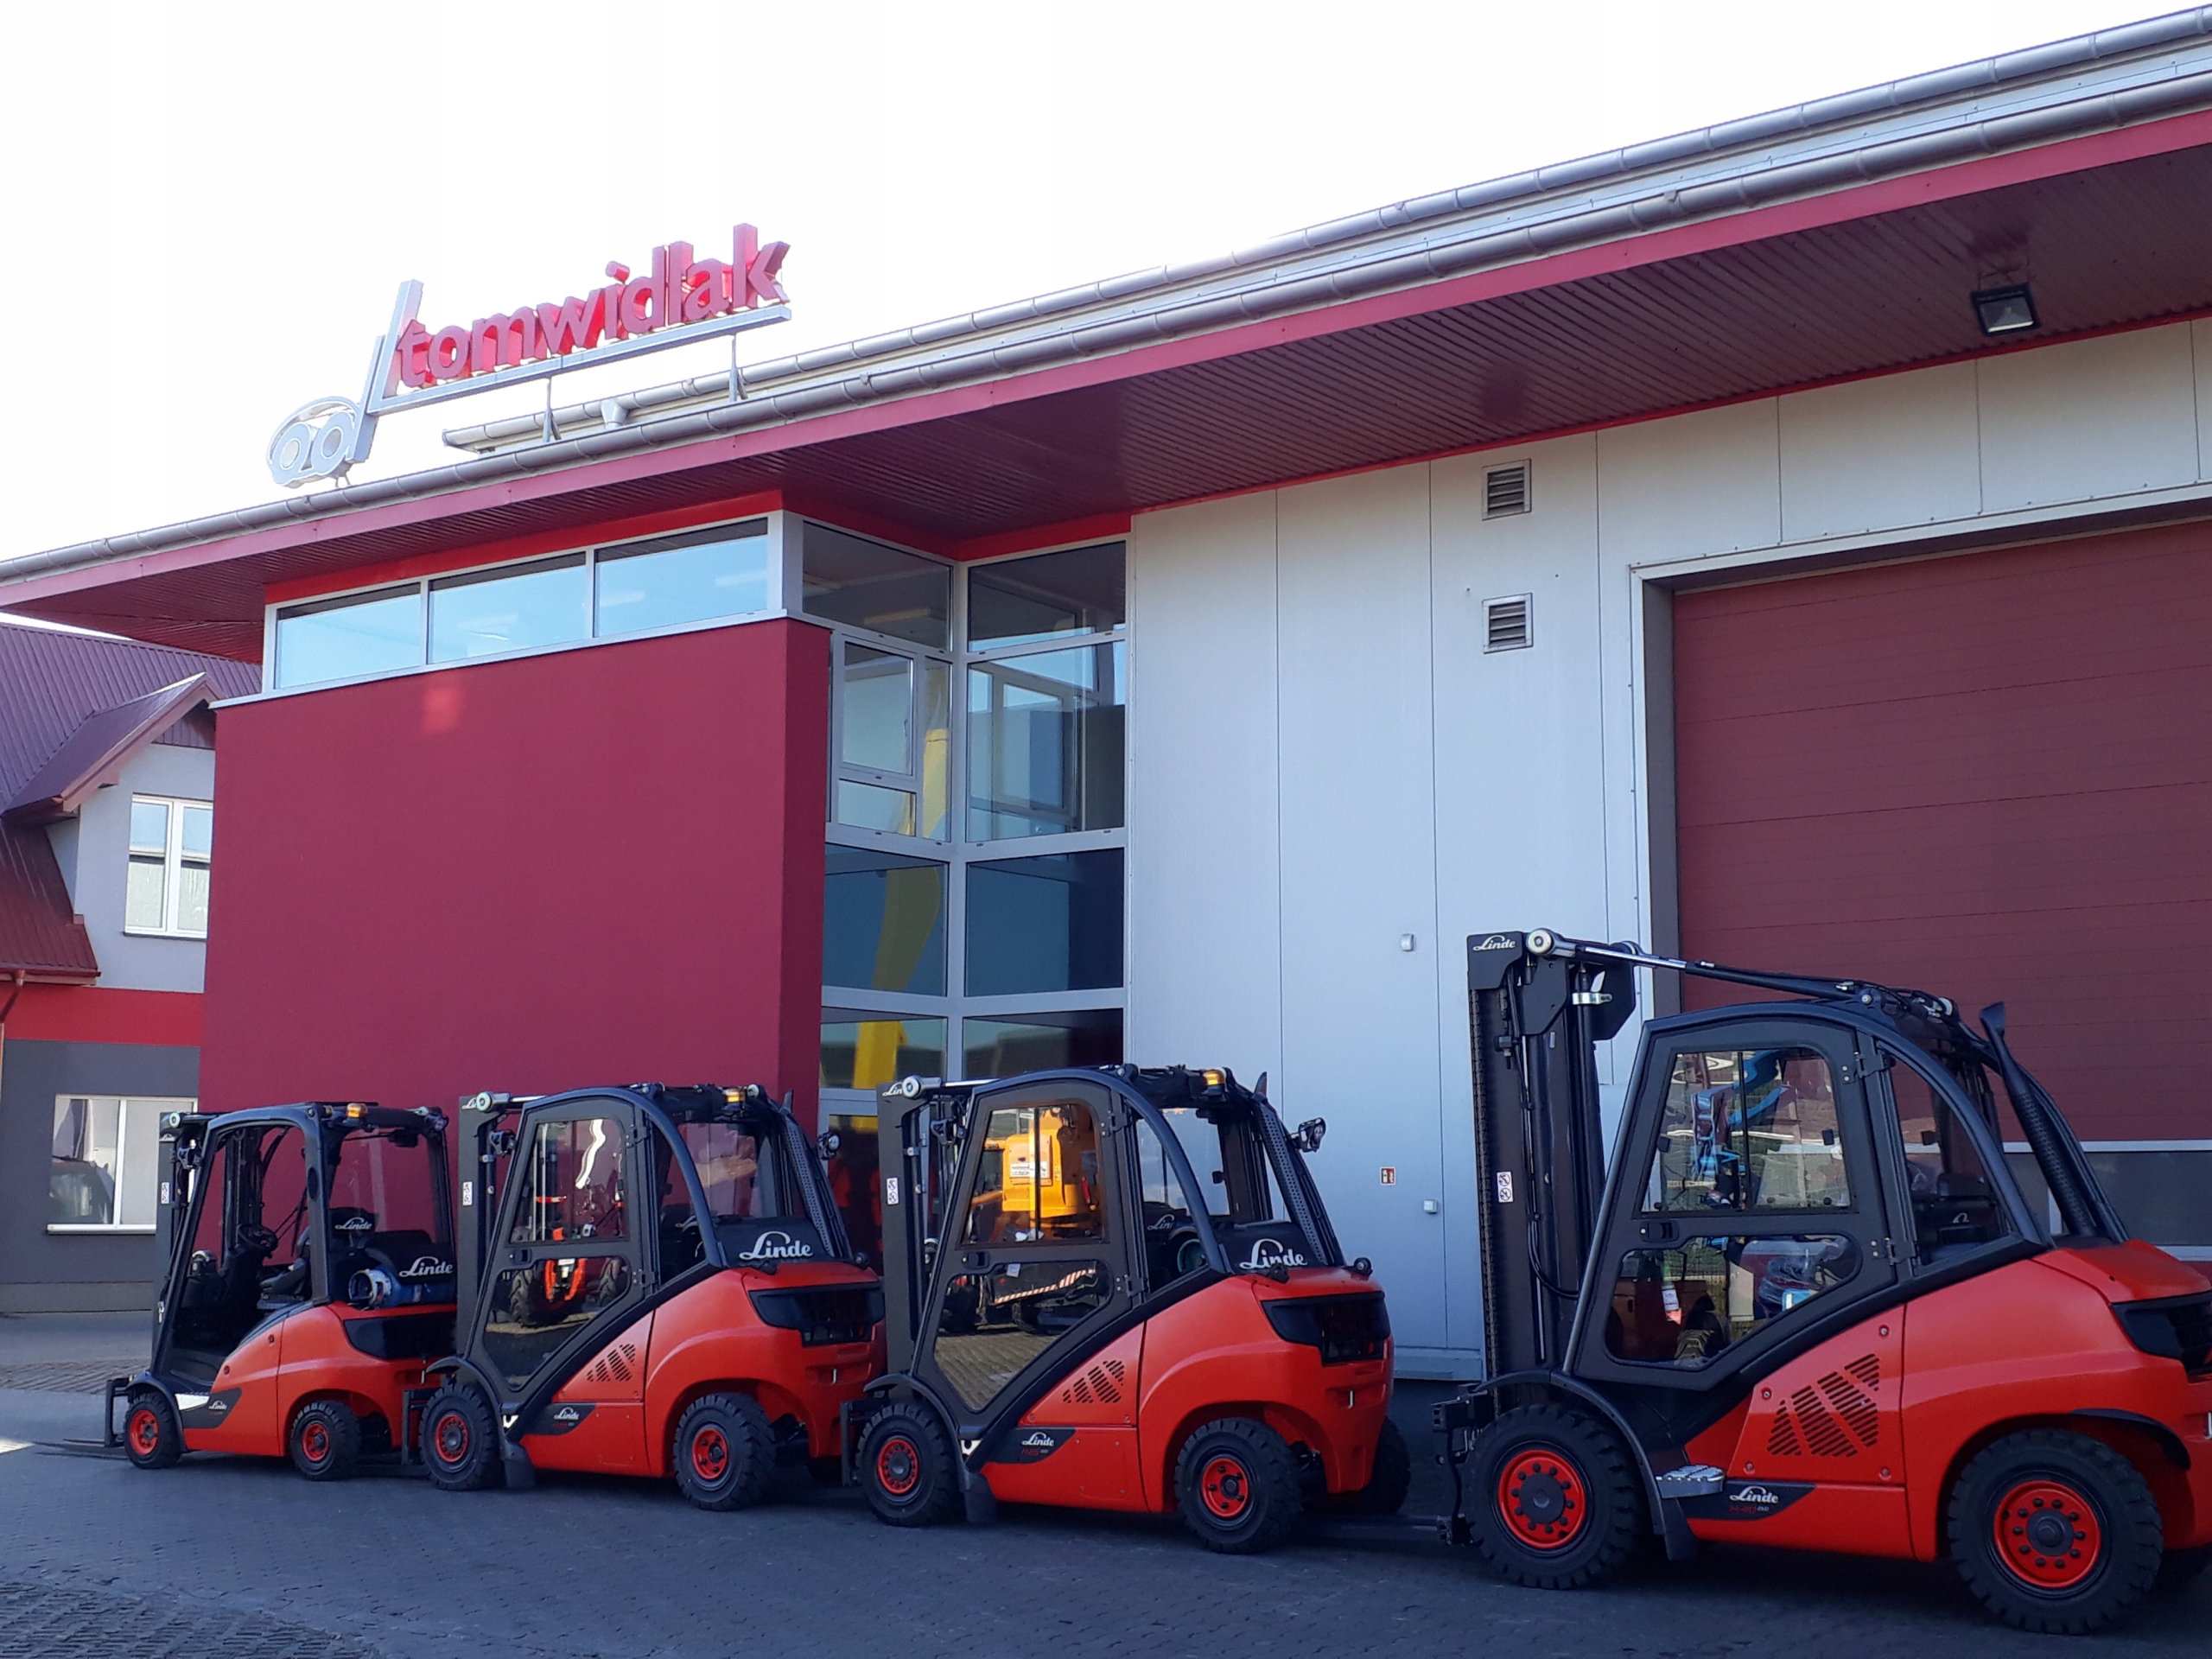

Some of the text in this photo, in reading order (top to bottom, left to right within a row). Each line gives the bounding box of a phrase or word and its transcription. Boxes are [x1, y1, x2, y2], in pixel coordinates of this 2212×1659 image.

[397, 222, 791, 390] tomwidlak
[1472, 935, 1516, 951] Linde
[881, 1082, 904, 1096] Lin
[334, 1217, 372, 1230] Linde
[1147, 1214, 1175, 1230] Lin
[739, 1230, 814, 1261] Linde
[1239, 1238, 1308, 1269] Linde
[398, 1255, 454, 1278] Linde
[1021, 1432, 1055, 1446] Linde
[1729, 1485, 1779, 1503] Linde
